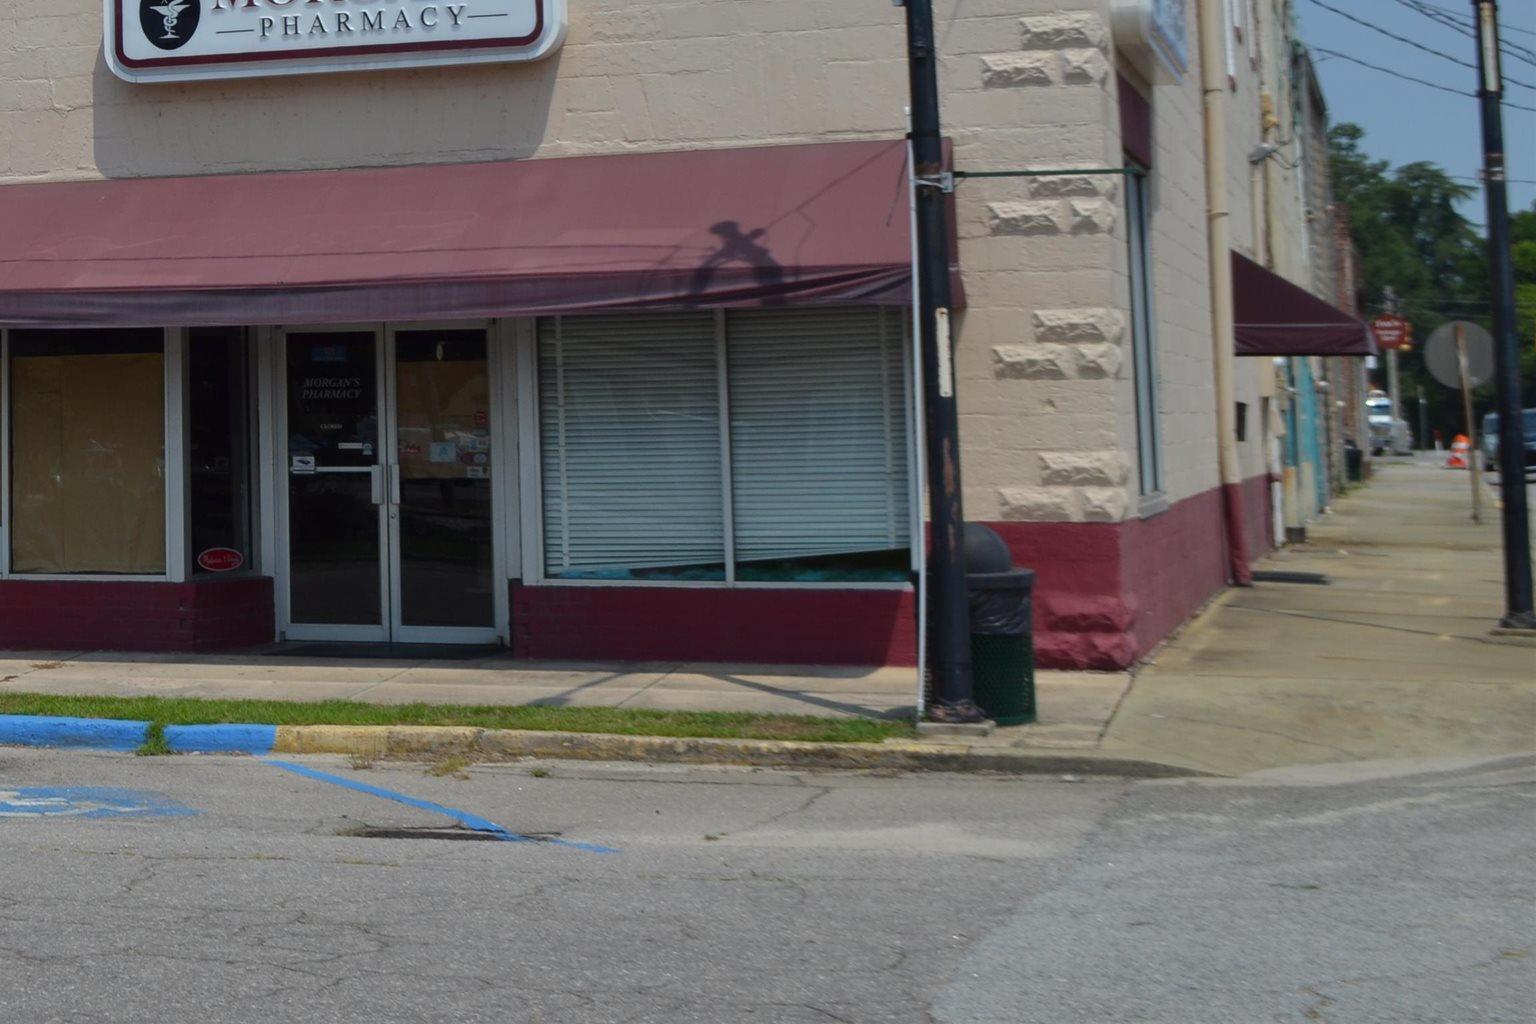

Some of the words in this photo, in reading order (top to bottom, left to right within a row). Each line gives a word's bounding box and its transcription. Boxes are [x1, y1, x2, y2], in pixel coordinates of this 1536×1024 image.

[259, 5, 467, 38] PHARMACY
[303, 377, 361, 388] MORGAN'S
[302, 388, 362, 400] PHARMACY
